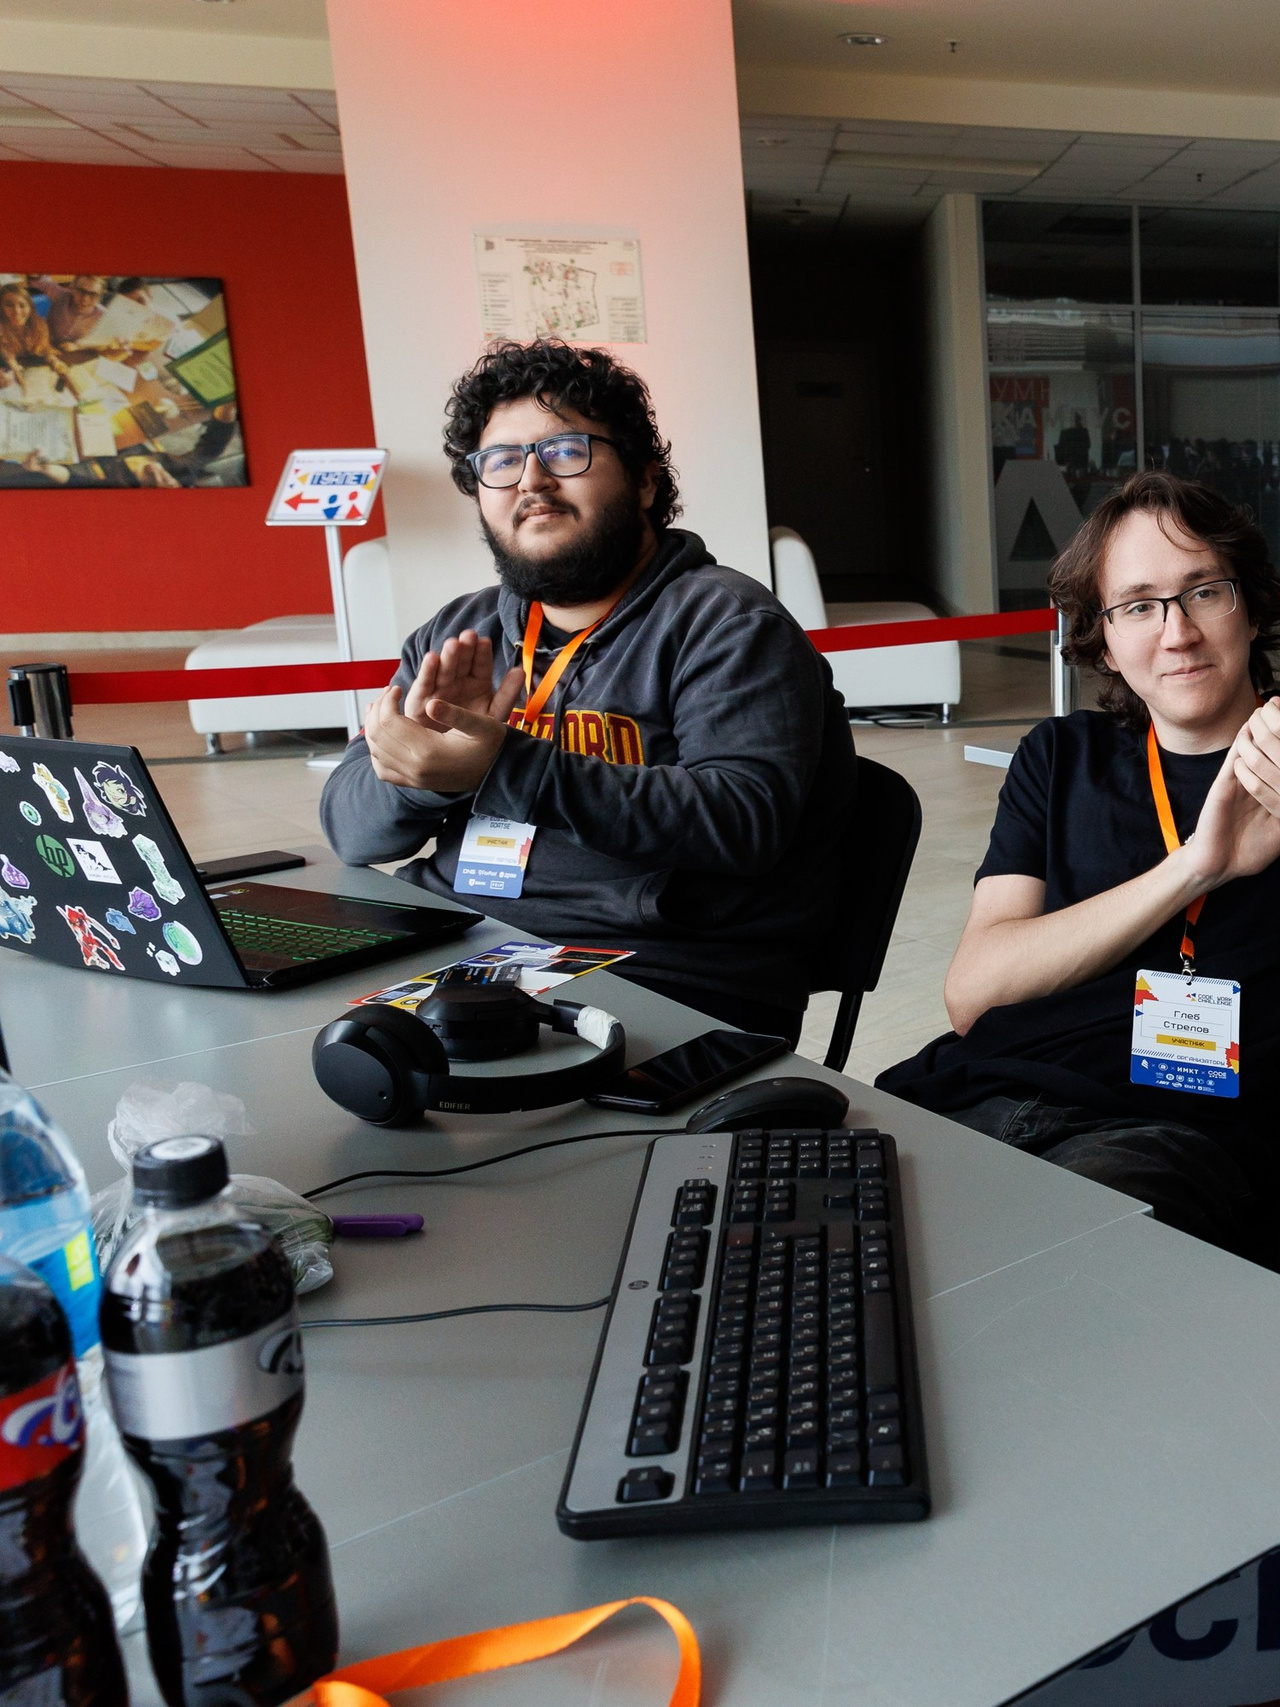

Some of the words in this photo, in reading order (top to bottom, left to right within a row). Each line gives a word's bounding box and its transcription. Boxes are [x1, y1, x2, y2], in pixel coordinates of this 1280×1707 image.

[1174, 1010, 1200, 1020] Глеб
[1164, 1020, 1210, 1034] Стрелов
[1172, 1038, 1205, 1047] УЧАСТНИК
[1176, 1055, 1226, 1066] ОРГАНИЗАТОРЫ
[1177, 1066, 1199, 1074] ИМКТ
[439, 1101, 471, 1110] EDIFIER
